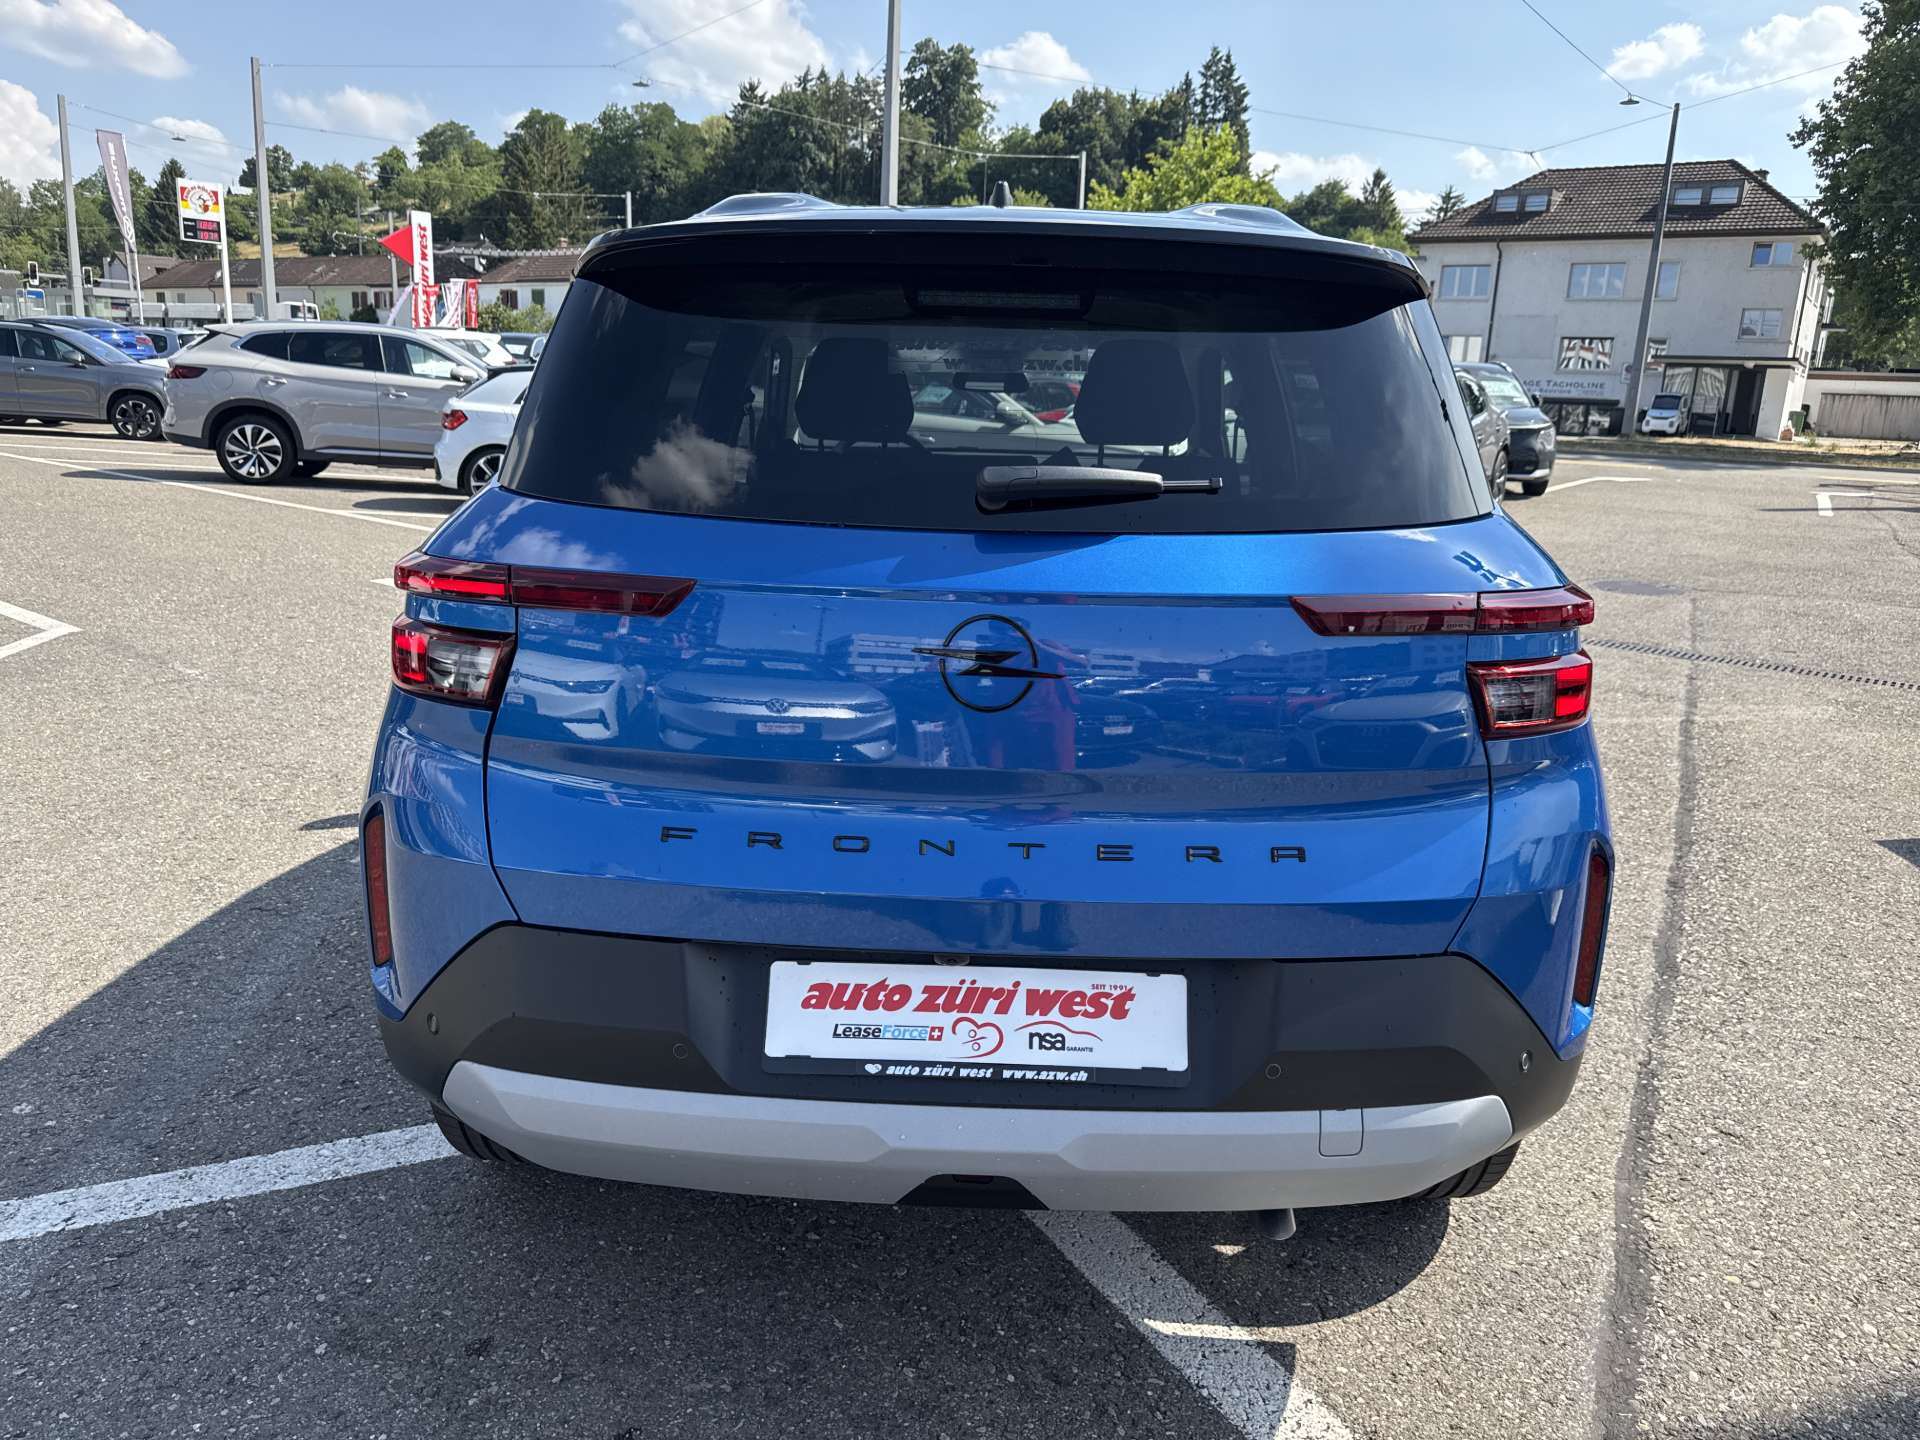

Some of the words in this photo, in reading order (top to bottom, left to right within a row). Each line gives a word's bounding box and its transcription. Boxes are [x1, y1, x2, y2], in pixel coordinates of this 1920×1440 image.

[418, 223, 428, 261] west
[660, 826, 1307, 863] FRONTERA
[800, 977, 912, 1012] auto
[912, 979, 1021, 1015] züri
[1025, 986, 1136, 1020] west
[833, 1024, 928, 1040] LeaseForce
[1028, 1031, 1066, 1051] nsa
[886, 1065, 919, 1075] auto
[923, 1064, 955, 1077] züri
[959, 1067, 993, 1079] west
[1002, 1068, 1088, 1082] www.azw.ch
